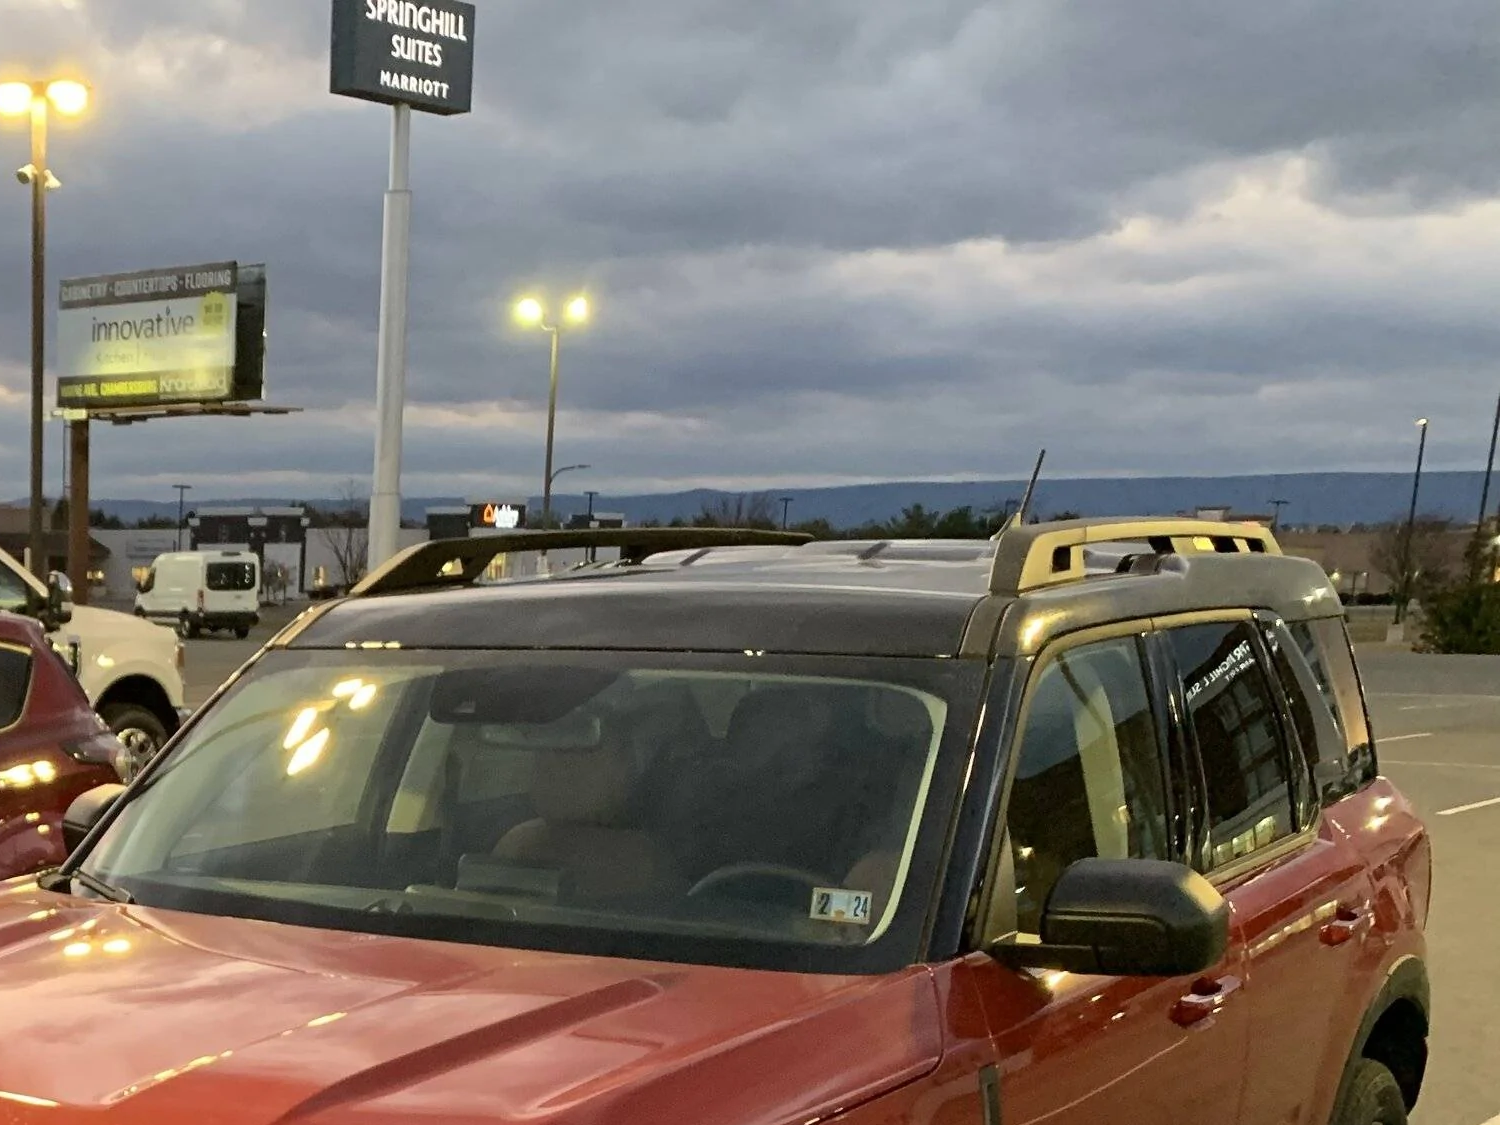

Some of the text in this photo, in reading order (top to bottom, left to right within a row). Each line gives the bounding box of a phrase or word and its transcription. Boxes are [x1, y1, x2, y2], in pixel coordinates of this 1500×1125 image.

[365, 0, 467, 42] SPRINGHILL
[391, 34, 442, 67] SUITES
[380, 70, 449, 99] MARRIOTT
[185, 269, 232, 289] FLOORING
[91, 306, 195, 342] innovative
[853, 896, 867, 918] 24
